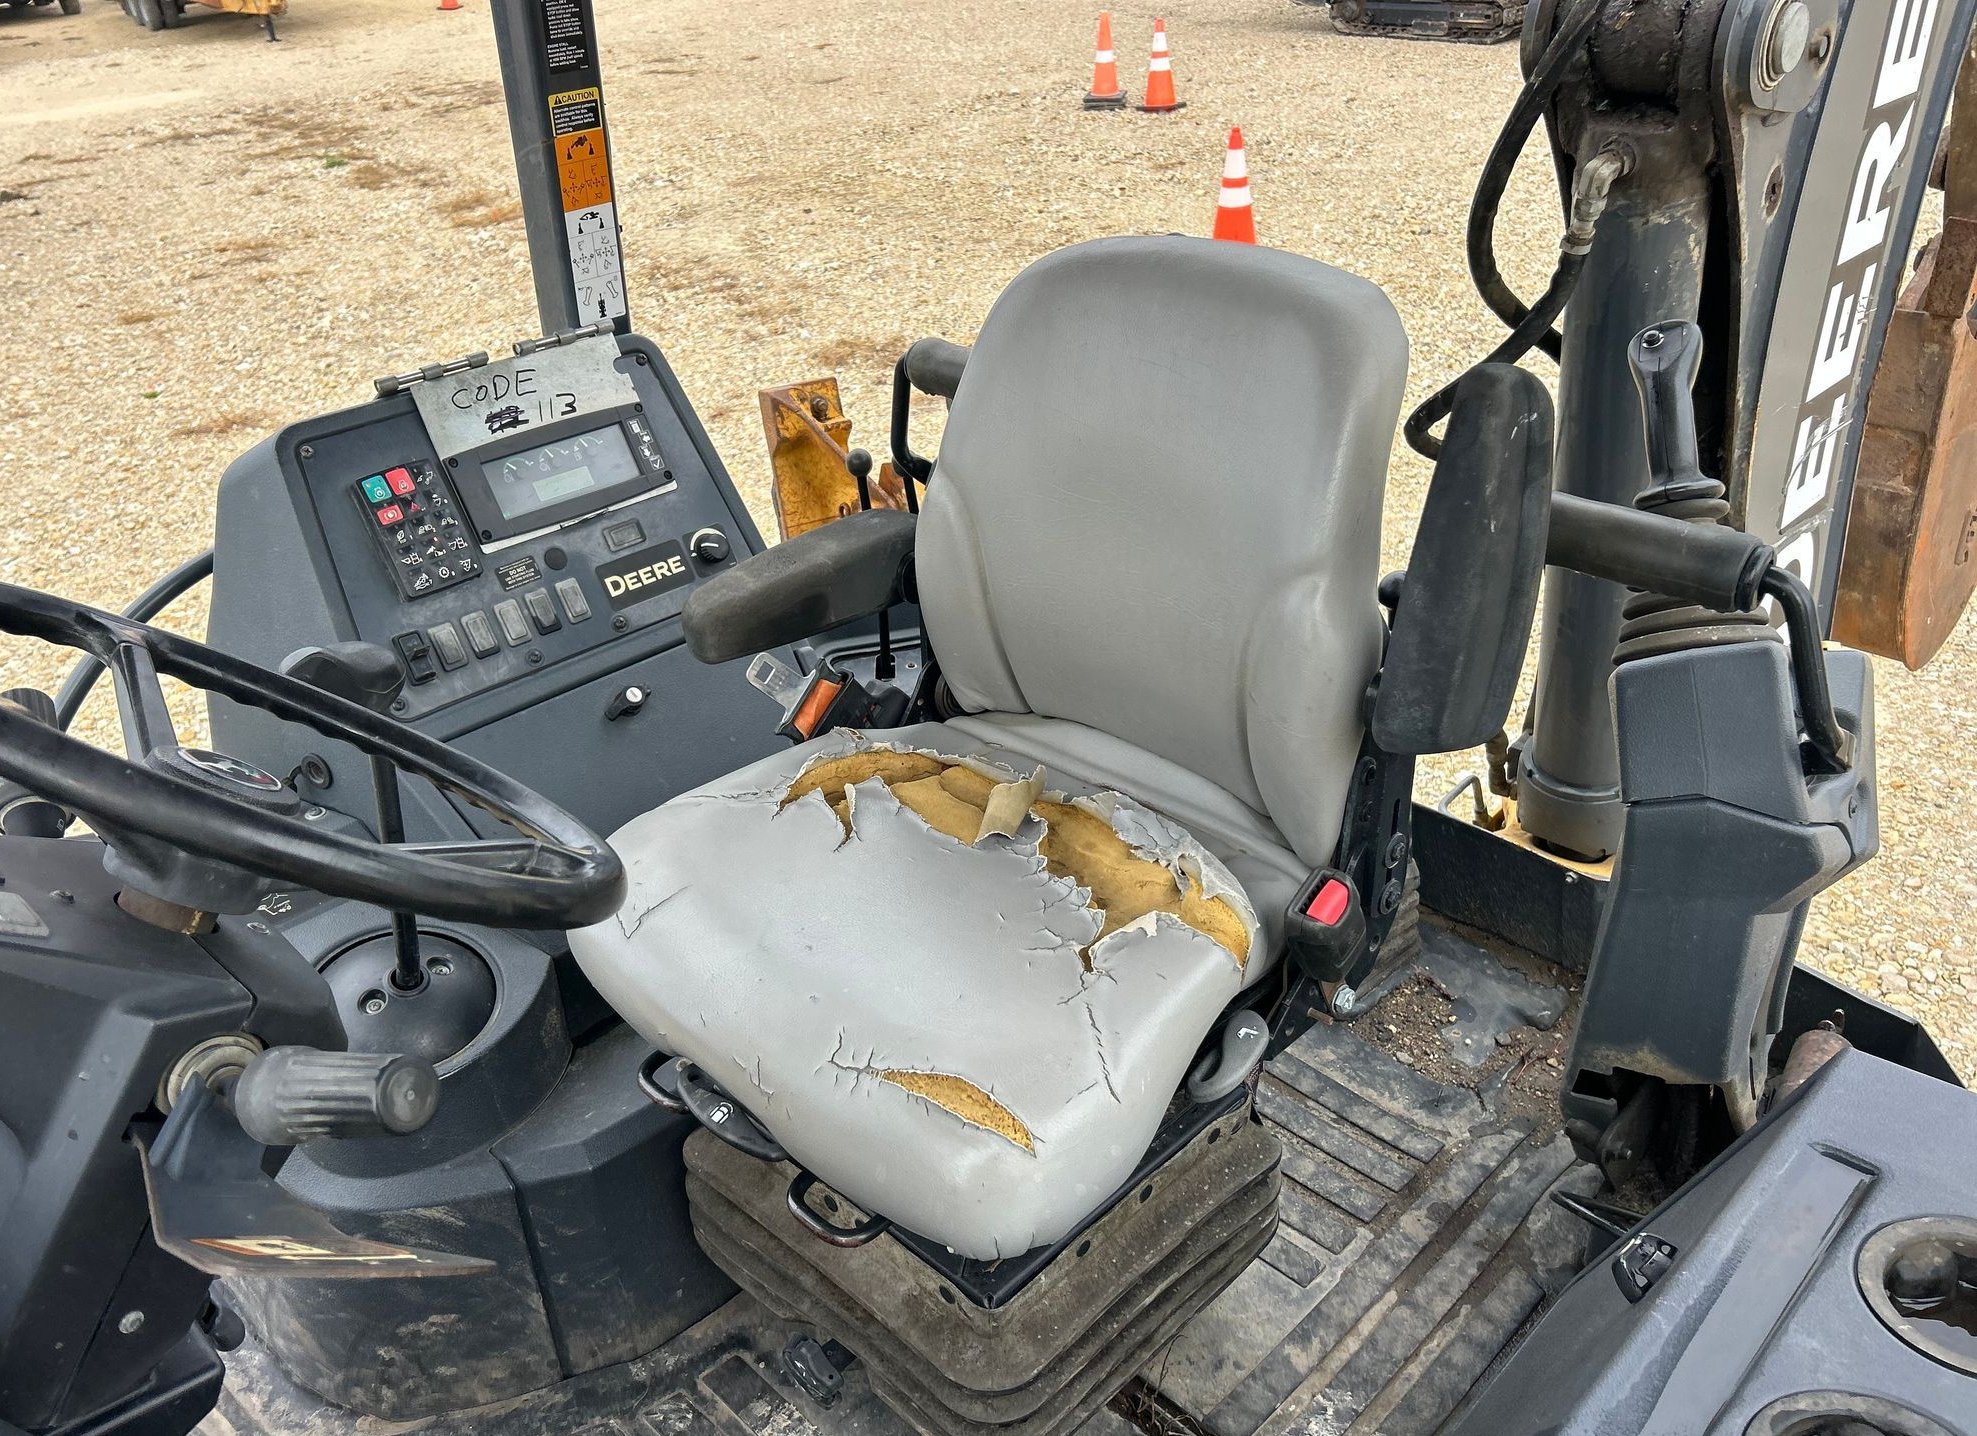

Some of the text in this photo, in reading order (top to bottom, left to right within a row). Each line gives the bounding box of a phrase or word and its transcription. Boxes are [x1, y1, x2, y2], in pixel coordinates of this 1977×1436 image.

[561, 91, 594, 103] CAUTION
[450, 368, 537, 409] CODE
[538, 392, 577, 422] 113
[604, 555, 686, 598] DEERE
